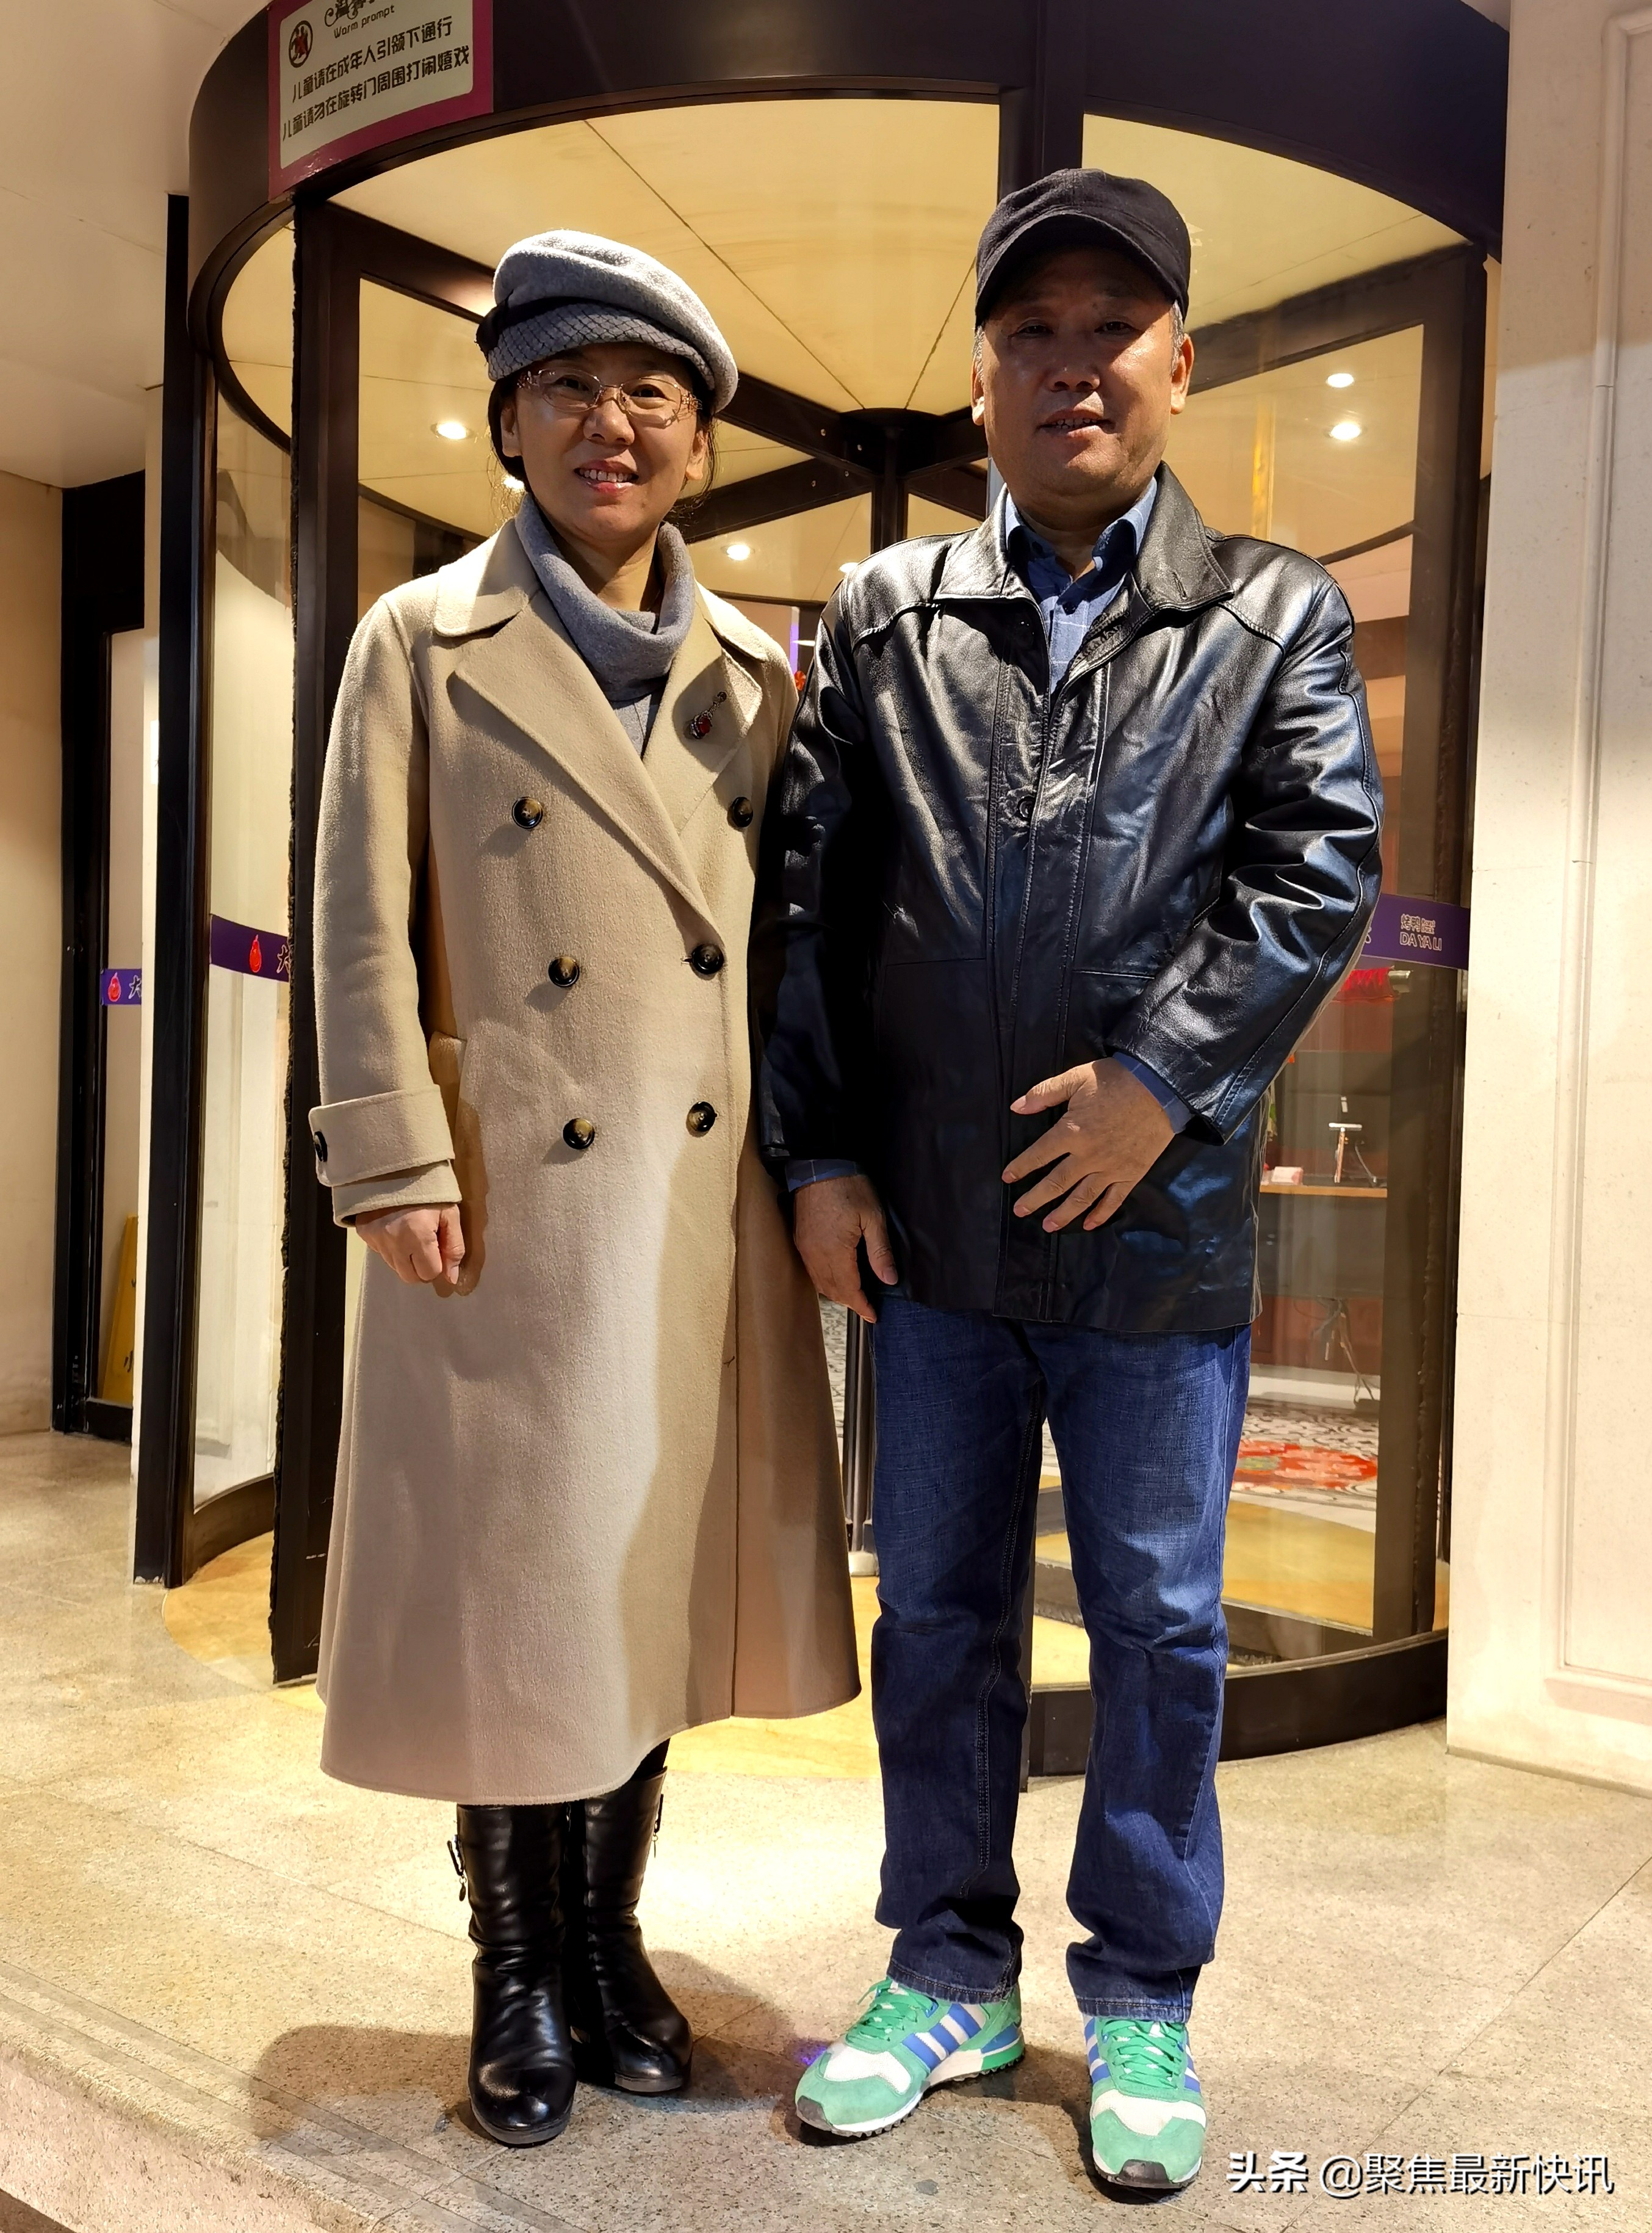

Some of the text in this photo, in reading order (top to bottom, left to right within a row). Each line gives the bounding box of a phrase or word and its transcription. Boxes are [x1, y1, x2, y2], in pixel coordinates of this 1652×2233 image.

[292, 16, 452, 103] 儿童请在成年人引领下通行
[334, 21, 358, 38] Warm
[361, 5, 395, 28] prompt
[283, 46, 469, 141] 儿童请勿在旋转门周围打闹嬉戏
